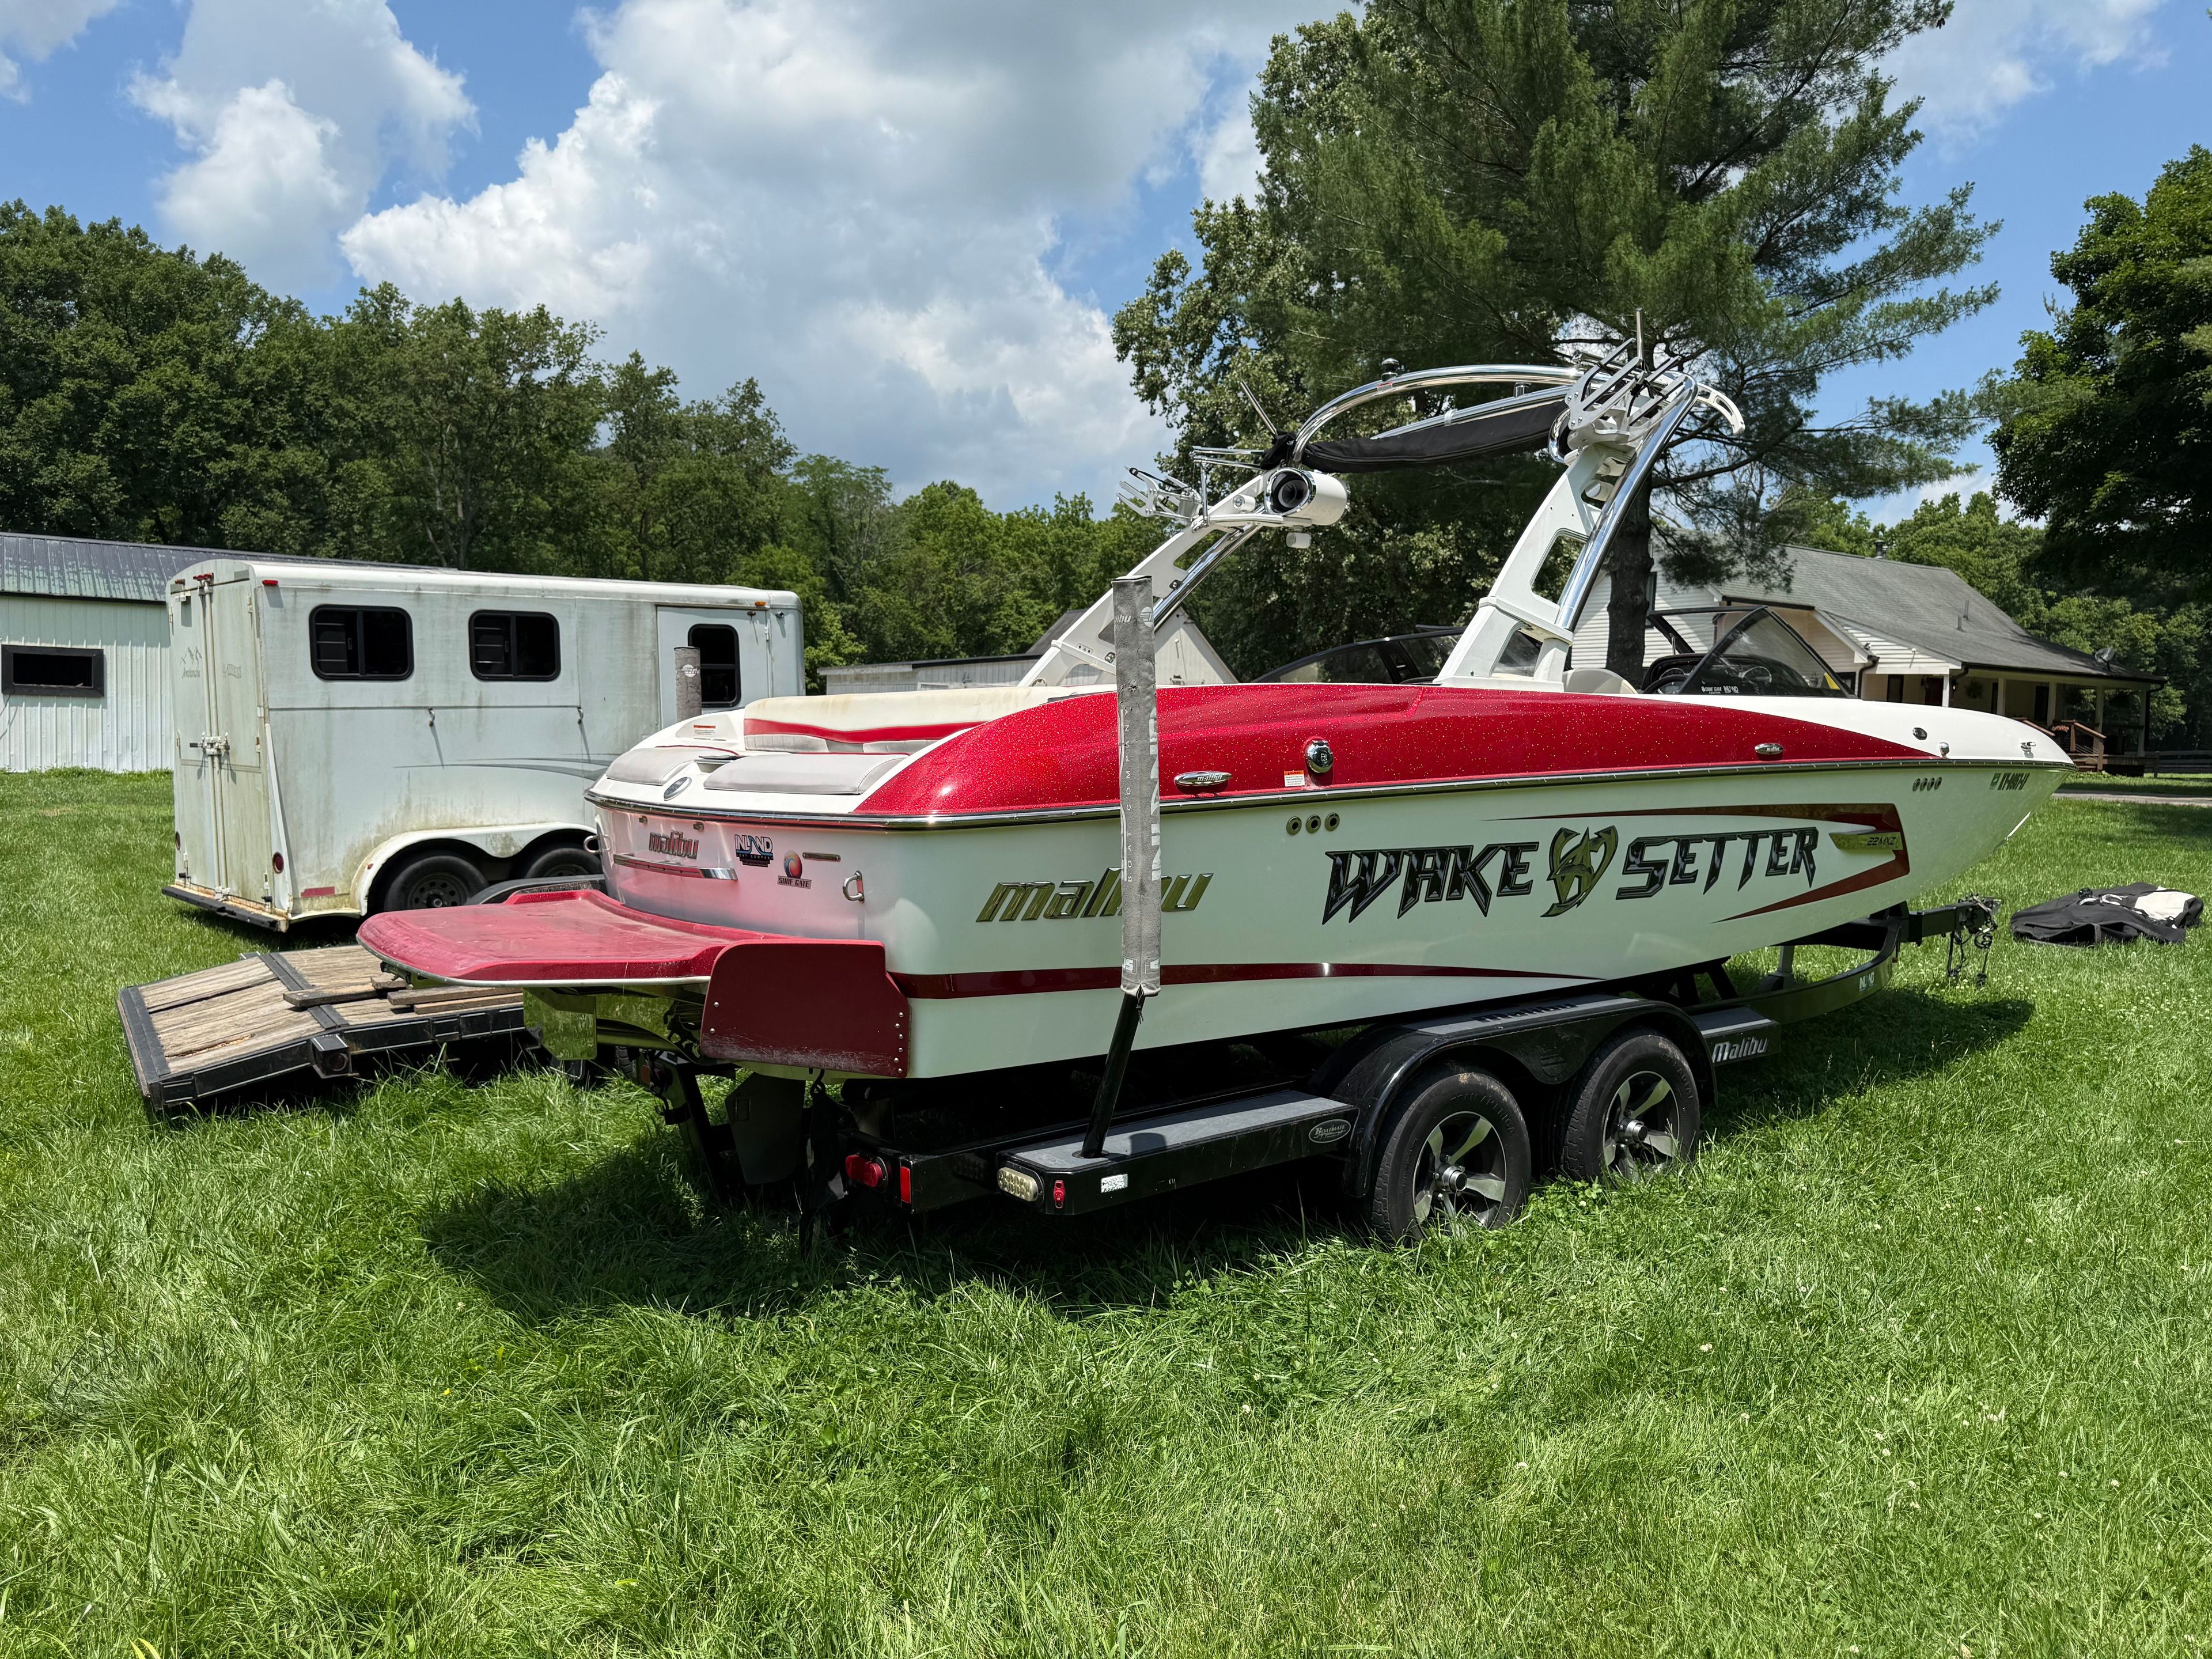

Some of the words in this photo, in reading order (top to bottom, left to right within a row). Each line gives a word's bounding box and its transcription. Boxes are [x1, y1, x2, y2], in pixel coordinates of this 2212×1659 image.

[649, 830, 699, 859] malibu
[778, 877, 794, 885] SURF
[794, 880, 810, 888] GATE
[975, 868, 1214, 923] maliu
[1321, 841, 1540, 925] WAKE
[1615, 826, 1820, 901] SETTER
